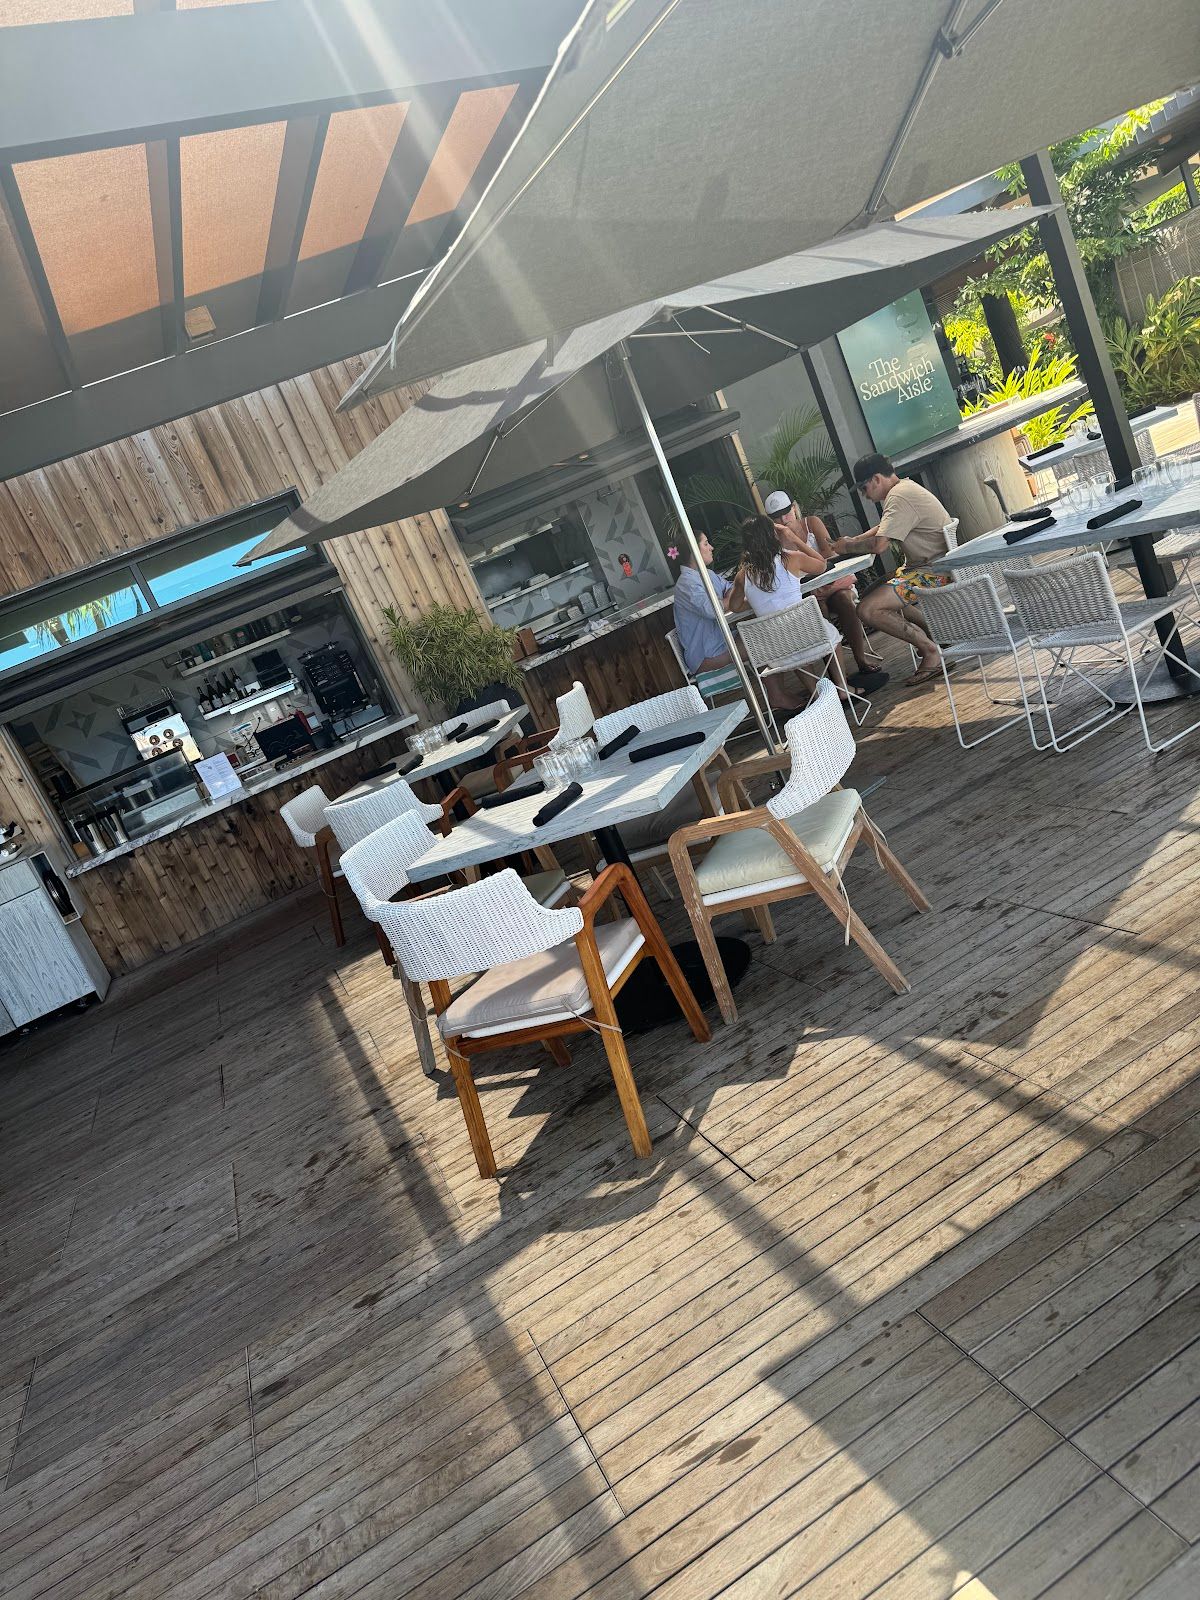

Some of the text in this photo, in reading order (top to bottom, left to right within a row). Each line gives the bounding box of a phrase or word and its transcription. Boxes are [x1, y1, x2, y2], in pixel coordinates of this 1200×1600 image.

[859, 356, 936, 401] Sandwich
[868, 357, 901, 379] The
[897, 376, 934, 404] Aisle
